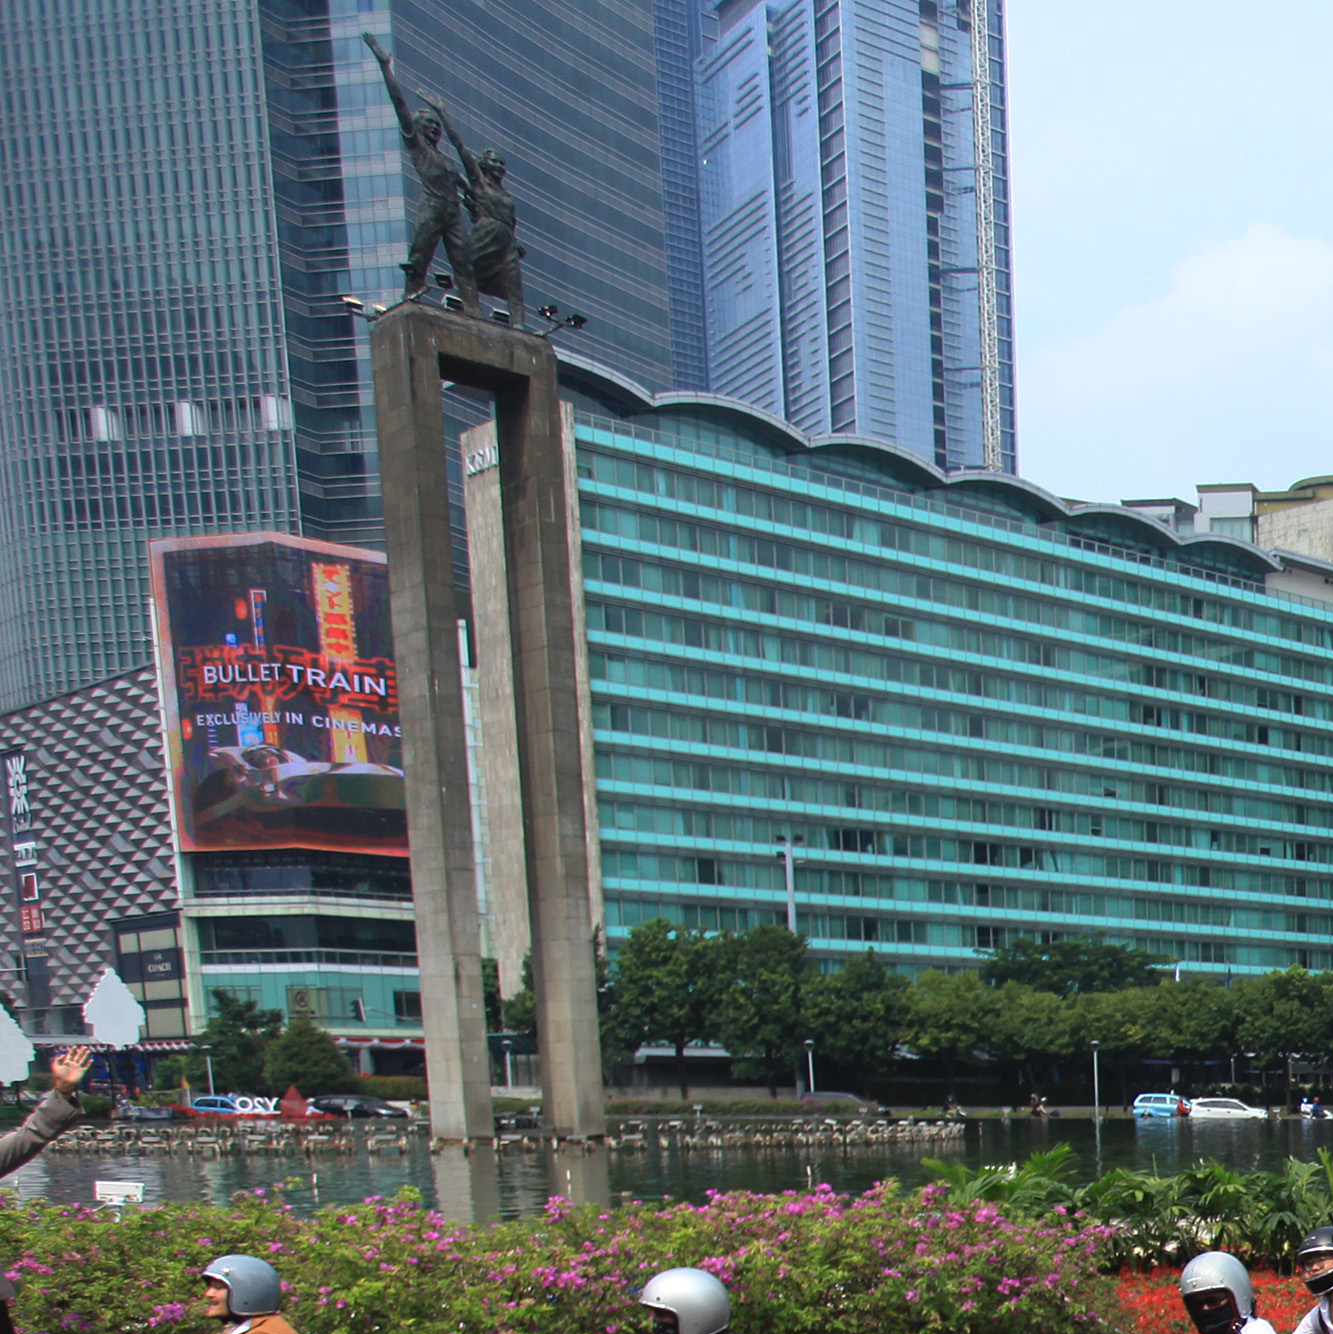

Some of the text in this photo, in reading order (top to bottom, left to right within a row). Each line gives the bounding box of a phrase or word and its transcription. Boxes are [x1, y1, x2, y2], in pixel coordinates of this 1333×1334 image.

[204, 663, 387, 696] BULLET TRAIN
[197, 711, 402, 738] EXCLUSIVELY IN CINEMAS
